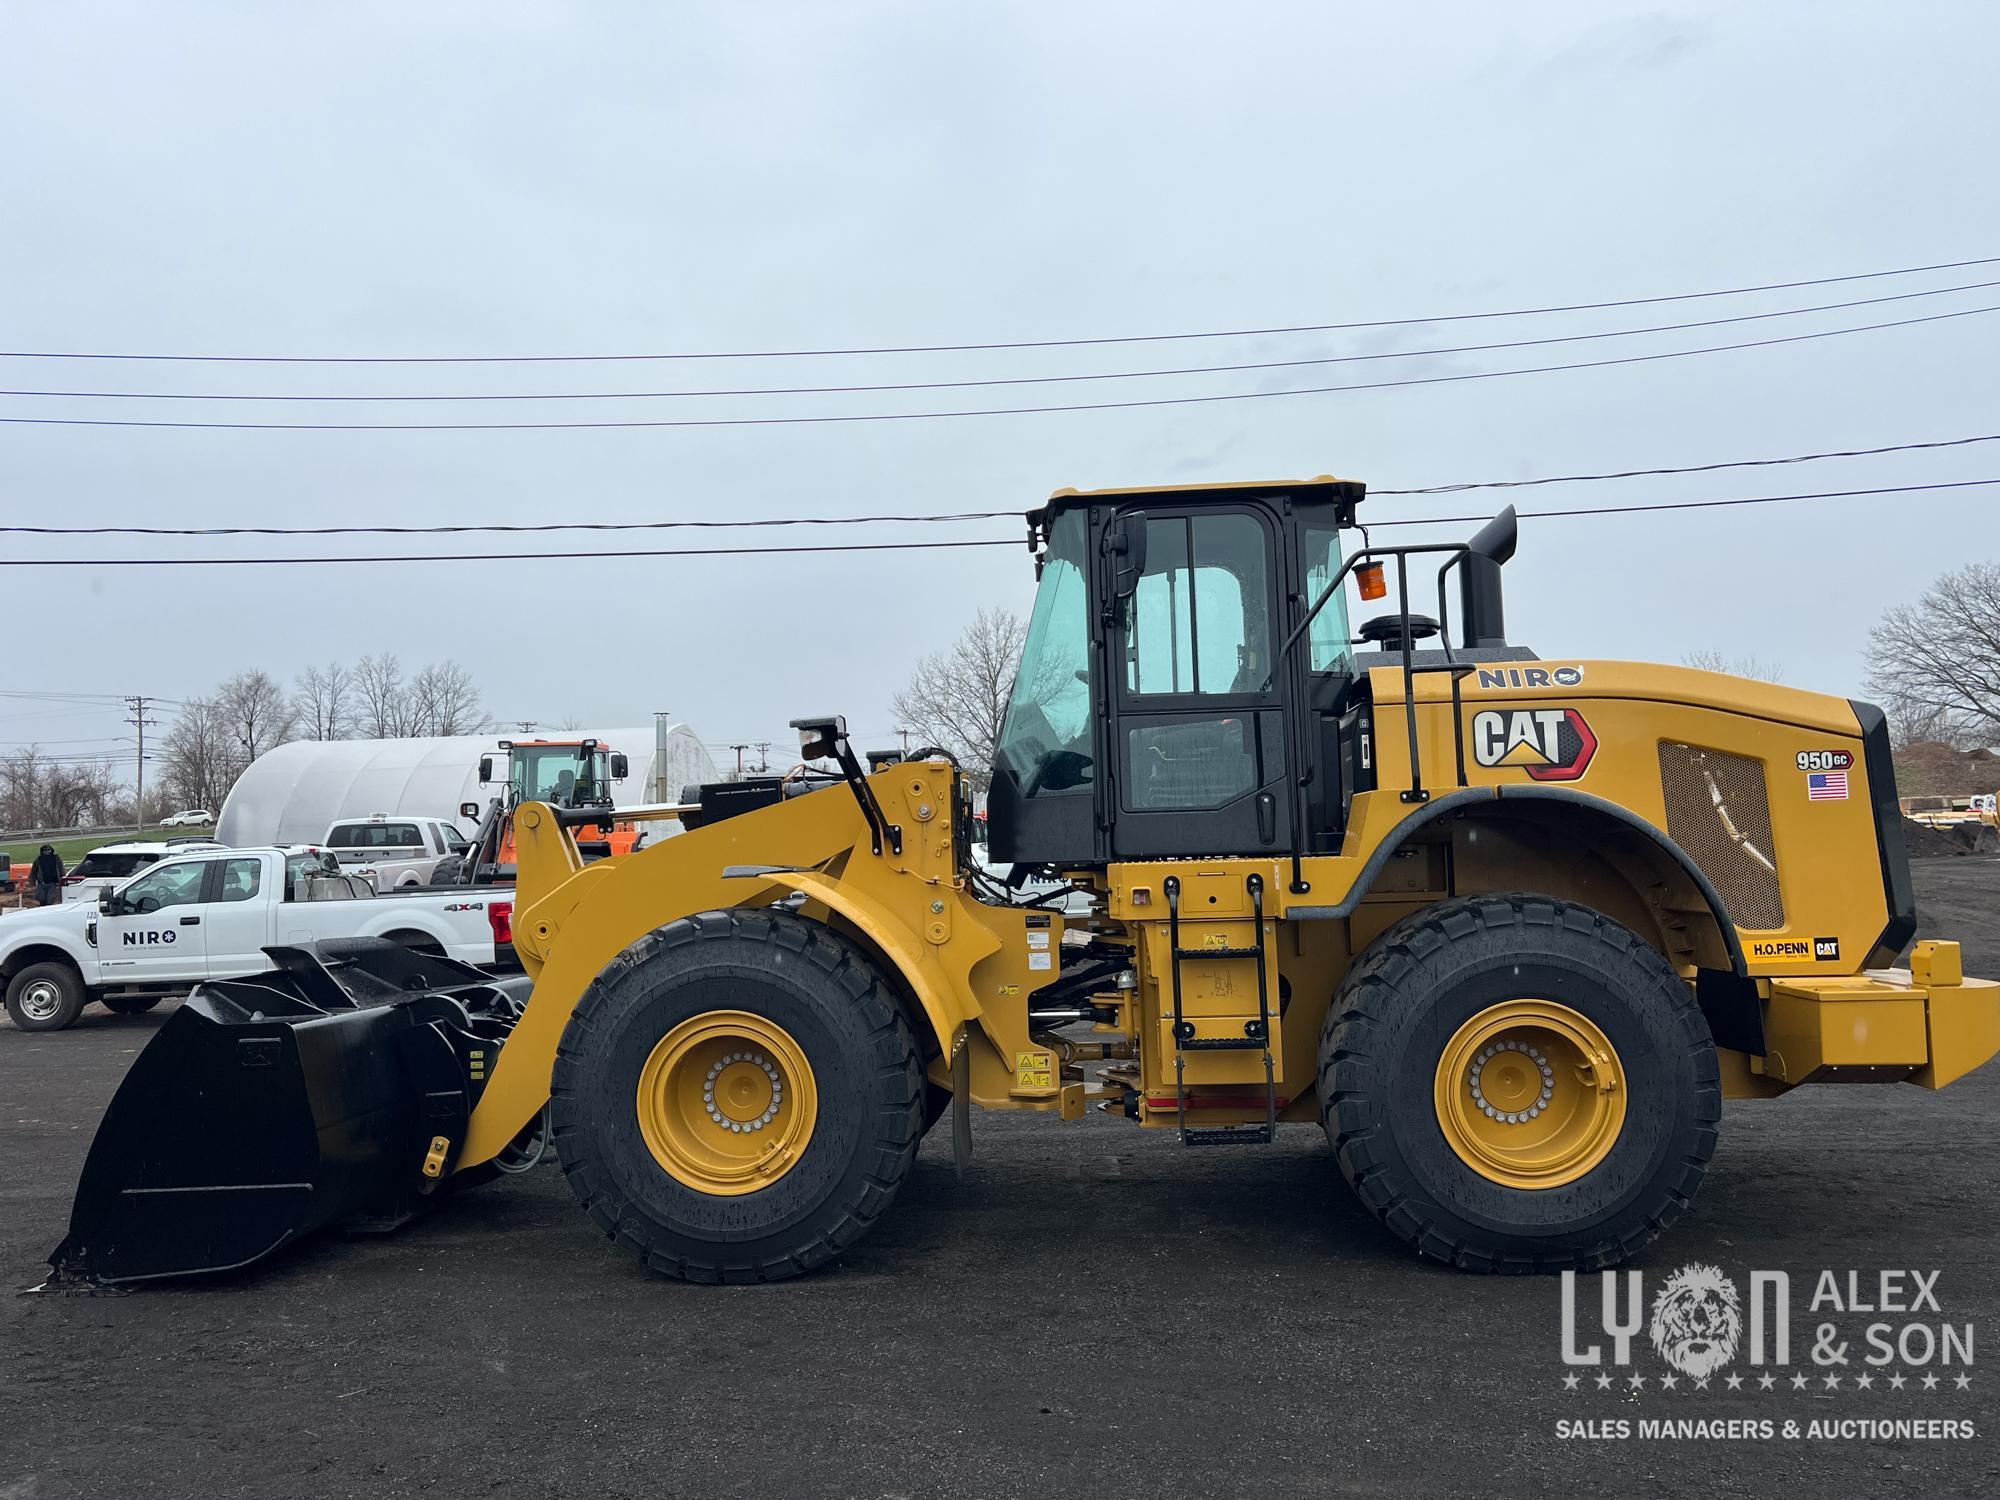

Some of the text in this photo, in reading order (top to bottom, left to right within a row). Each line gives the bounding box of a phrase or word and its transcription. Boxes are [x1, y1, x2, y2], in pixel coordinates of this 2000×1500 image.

[1478, 667, 1582, 688] NIRO
[1474, 710, 1565, 766] CAT
[1797, 751, 1847, 770] 950 GC
[123, 930, 176, 945] NIRO
[1816, 943, 1837, 955] CAT
